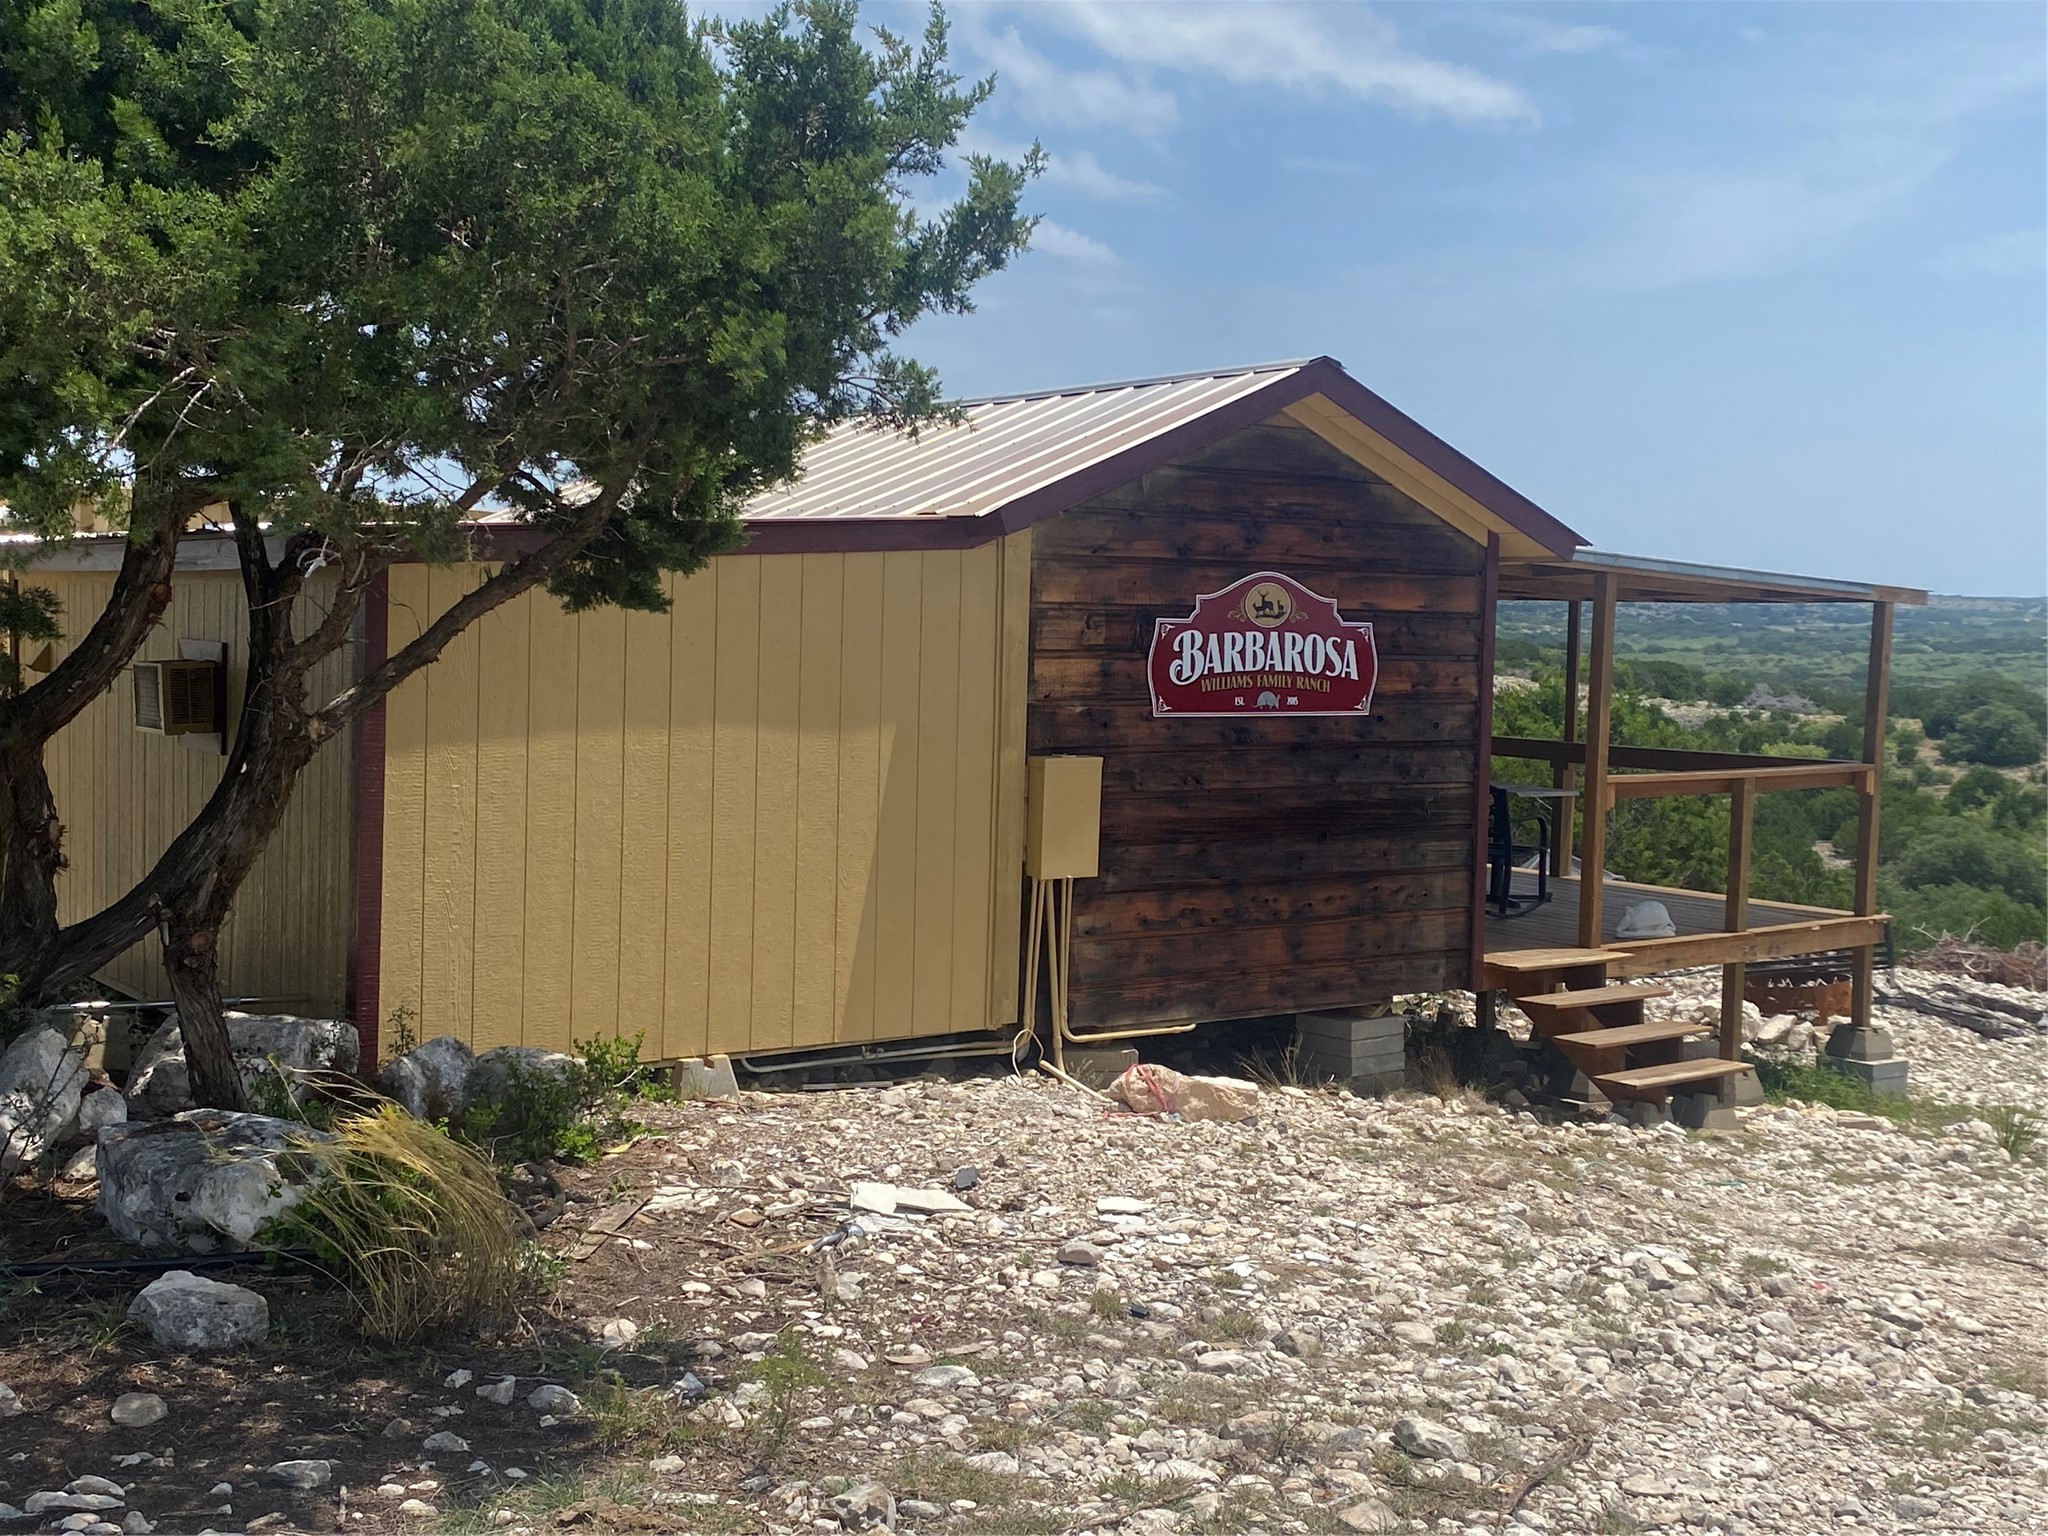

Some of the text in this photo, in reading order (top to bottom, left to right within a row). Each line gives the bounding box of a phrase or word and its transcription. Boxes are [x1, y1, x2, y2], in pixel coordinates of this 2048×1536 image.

[1169, 629, 1359, 686] BARBAROSA
[1201, 674, 1331, 693] WILLIAMS FAMILY RANCH
